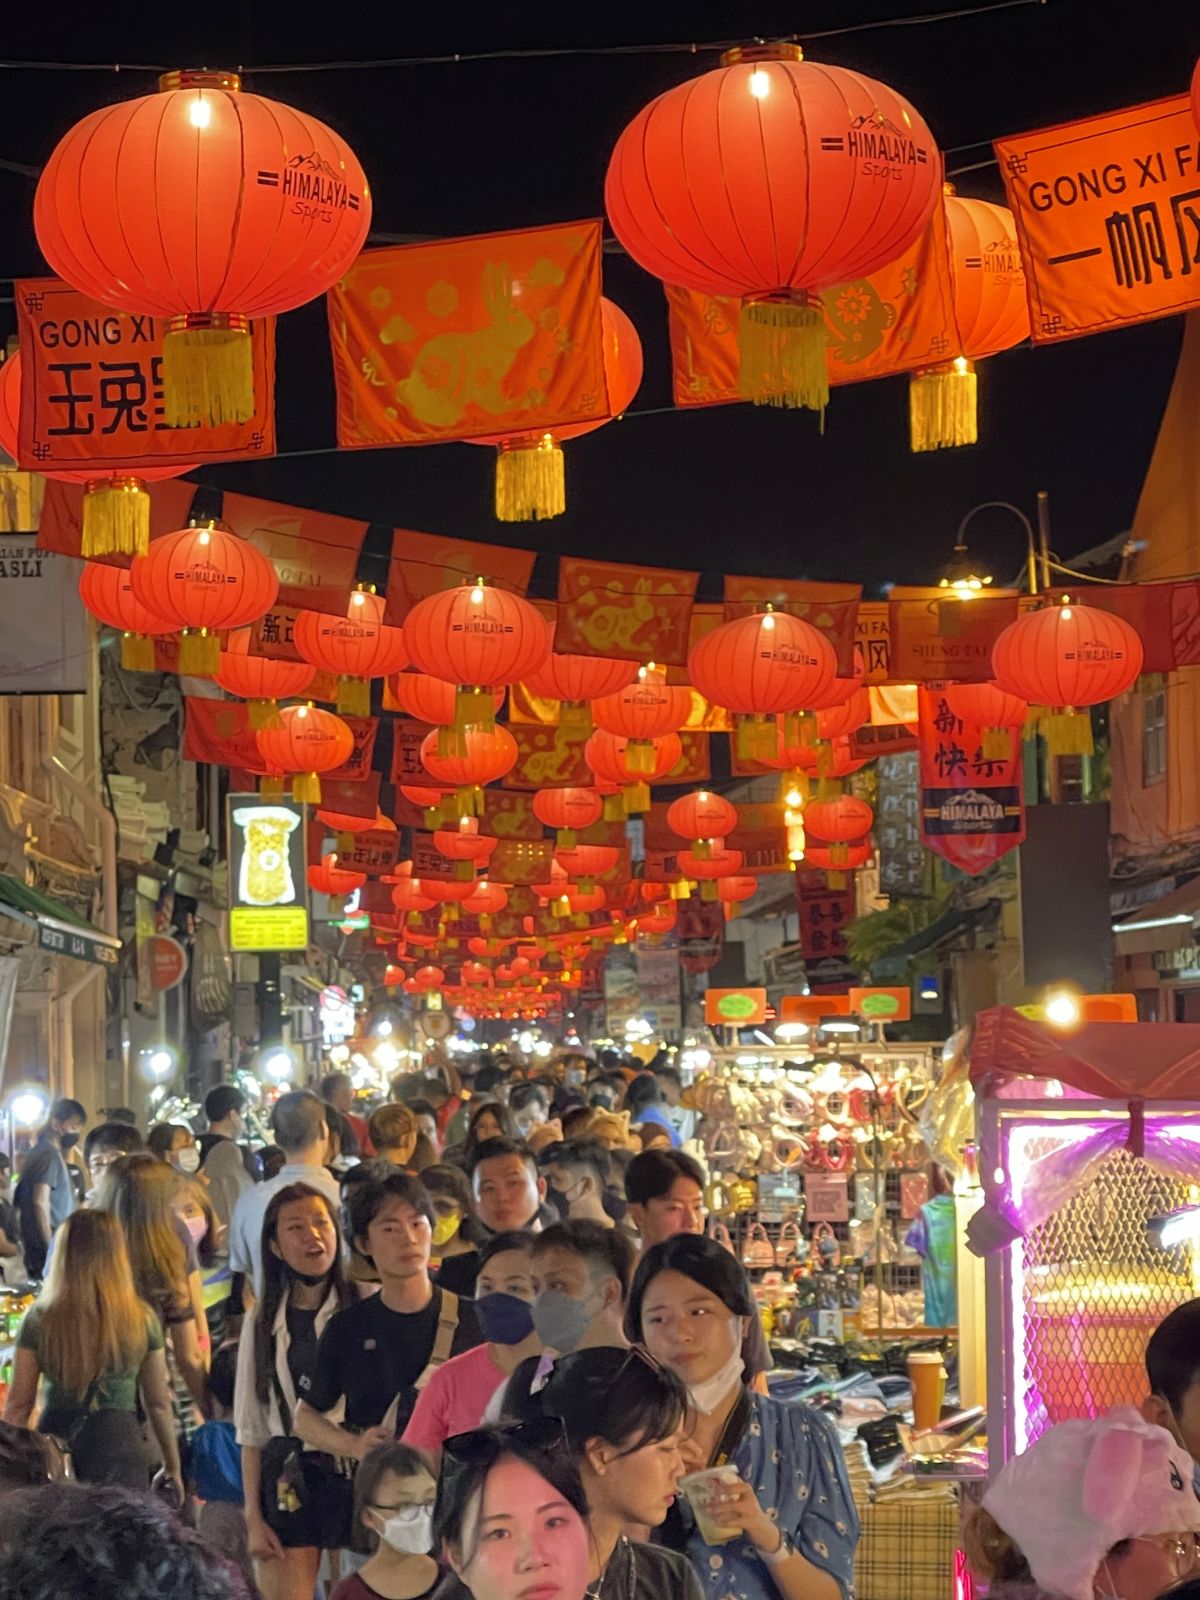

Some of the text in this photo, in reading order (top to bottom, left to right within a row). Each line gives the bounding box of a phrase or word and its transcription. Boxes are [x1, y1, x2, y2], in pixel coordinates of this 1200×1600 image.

[847, 131, 916, 166] HIMALAYA
[282, 168, 347, 210] HIMALAYA
[1028, 144, 1200, 212] GONG XI F
[40, 315, 155, 348] GONG XI
[48, 357, 205, 436] 玉兔
[464, 622, 503, 634] HIMALAYA
[940, 803, 1005, 821] HIMALAYA
